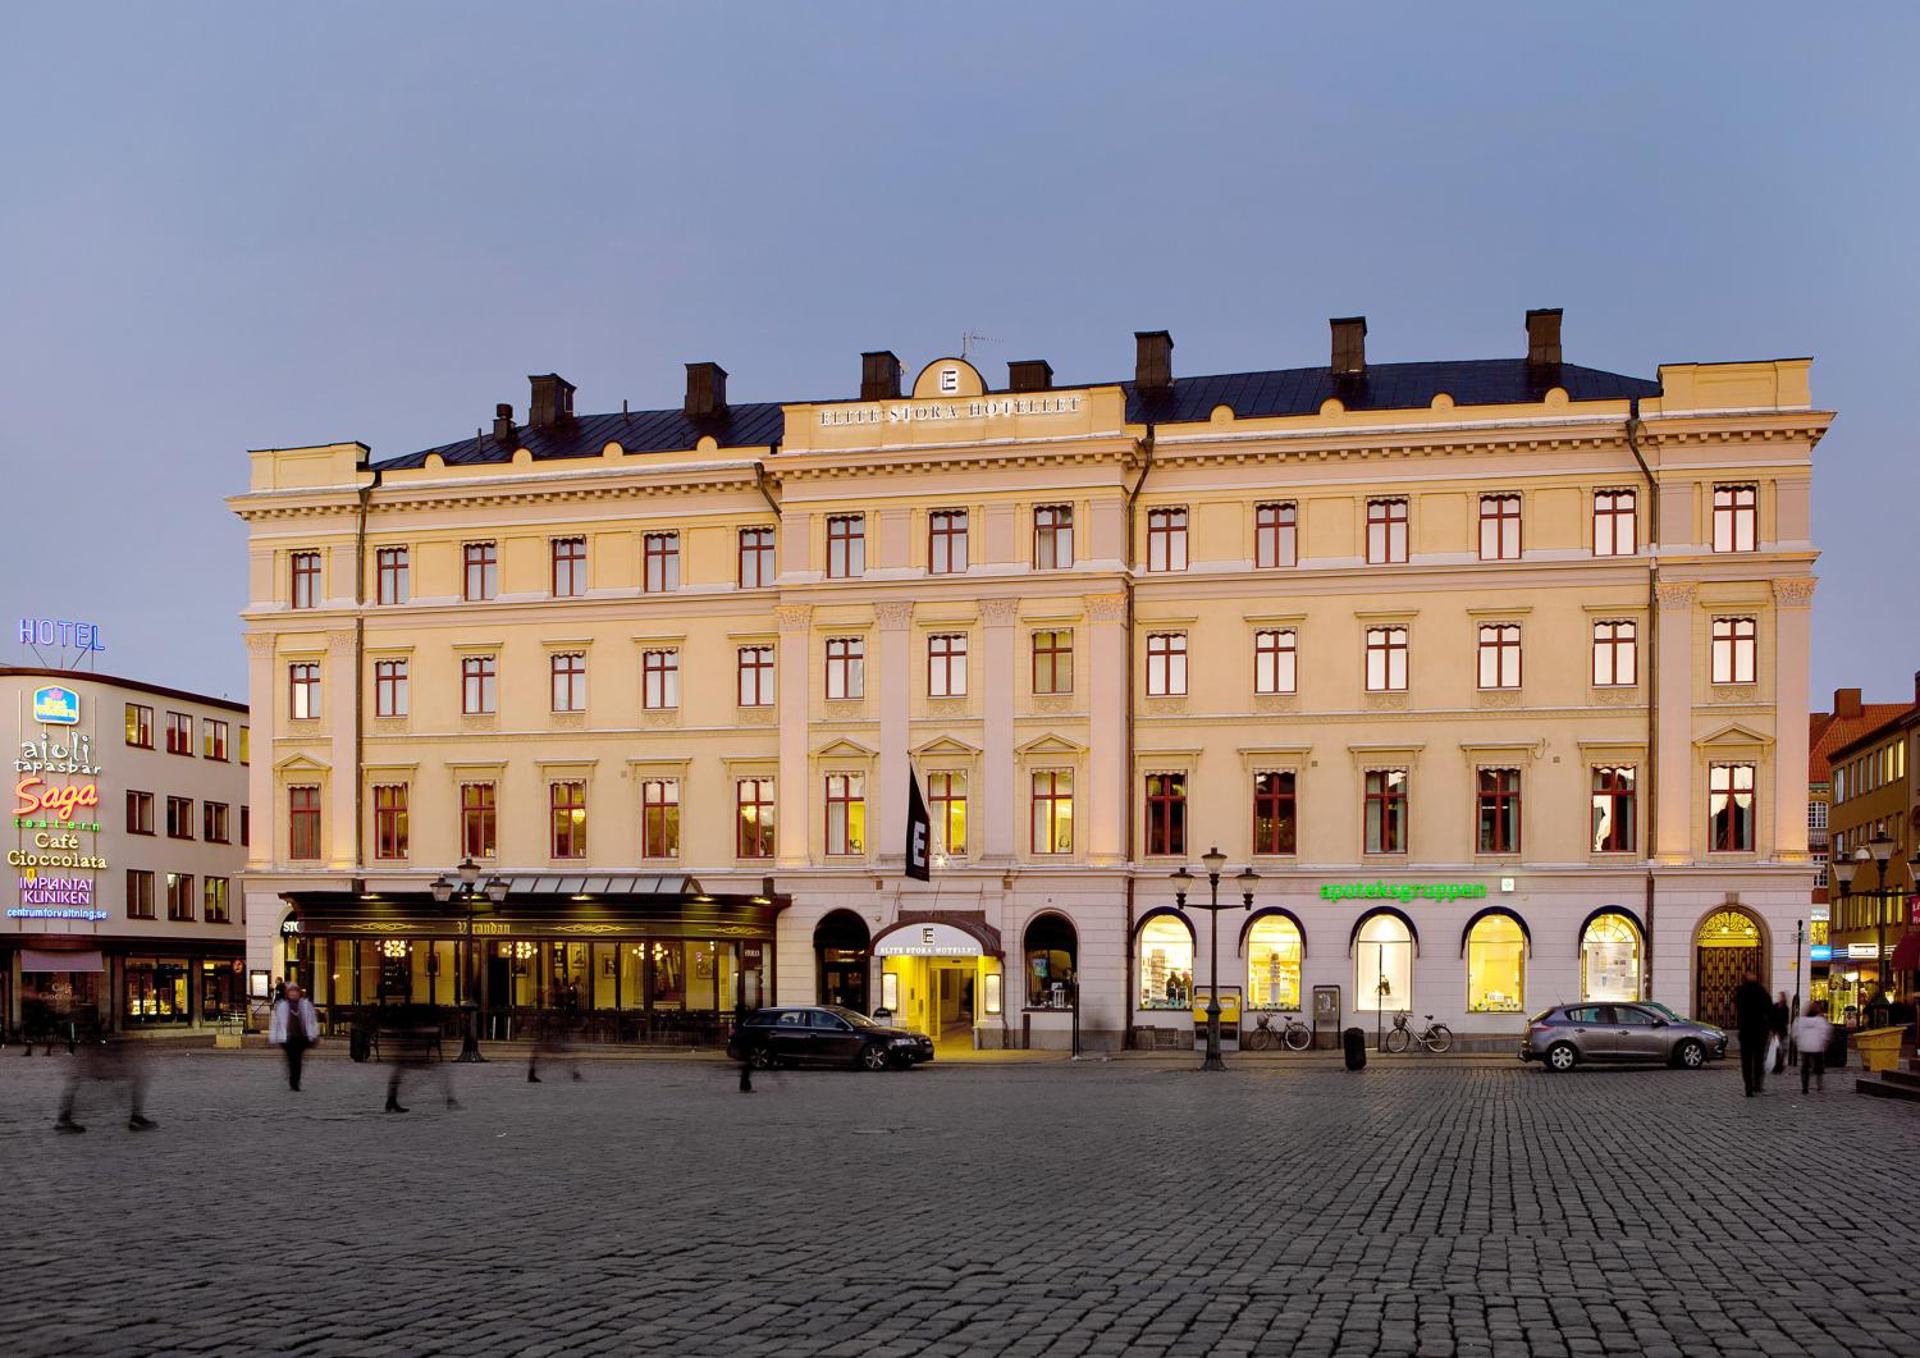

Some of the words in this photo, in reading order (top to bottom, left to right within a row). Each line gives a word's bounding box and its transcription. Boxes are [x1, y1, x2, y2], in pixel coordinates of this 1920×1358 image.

[941, 370, 957, 391] E
[820, 408, 881, 426] ELITE
[889, 403, 958, 423] STORA
[968, 396, 1081, 418] HOTELLET
[19, 618, 106, 651] HOTEL
[21, 731, 89, 764] aioli
[13, 757, 102, 776] tapasbar
[10, 777, 99, 820] Saga
[14, 818, 100, 832] teatern
[34, 832, 79, 849] Café
[913, 820, 926, 868] E
[7, 850, 107, 869] Cioccolata
[18, 876, 93, 892] IMPLANTAT
[1319, 880, 1487, 902] apoteksgruppen
[23, 890, 90, 905] KLINIKEN
[456, 921, 512, 935] Vrandan
[922, 927, 935, 944] E
